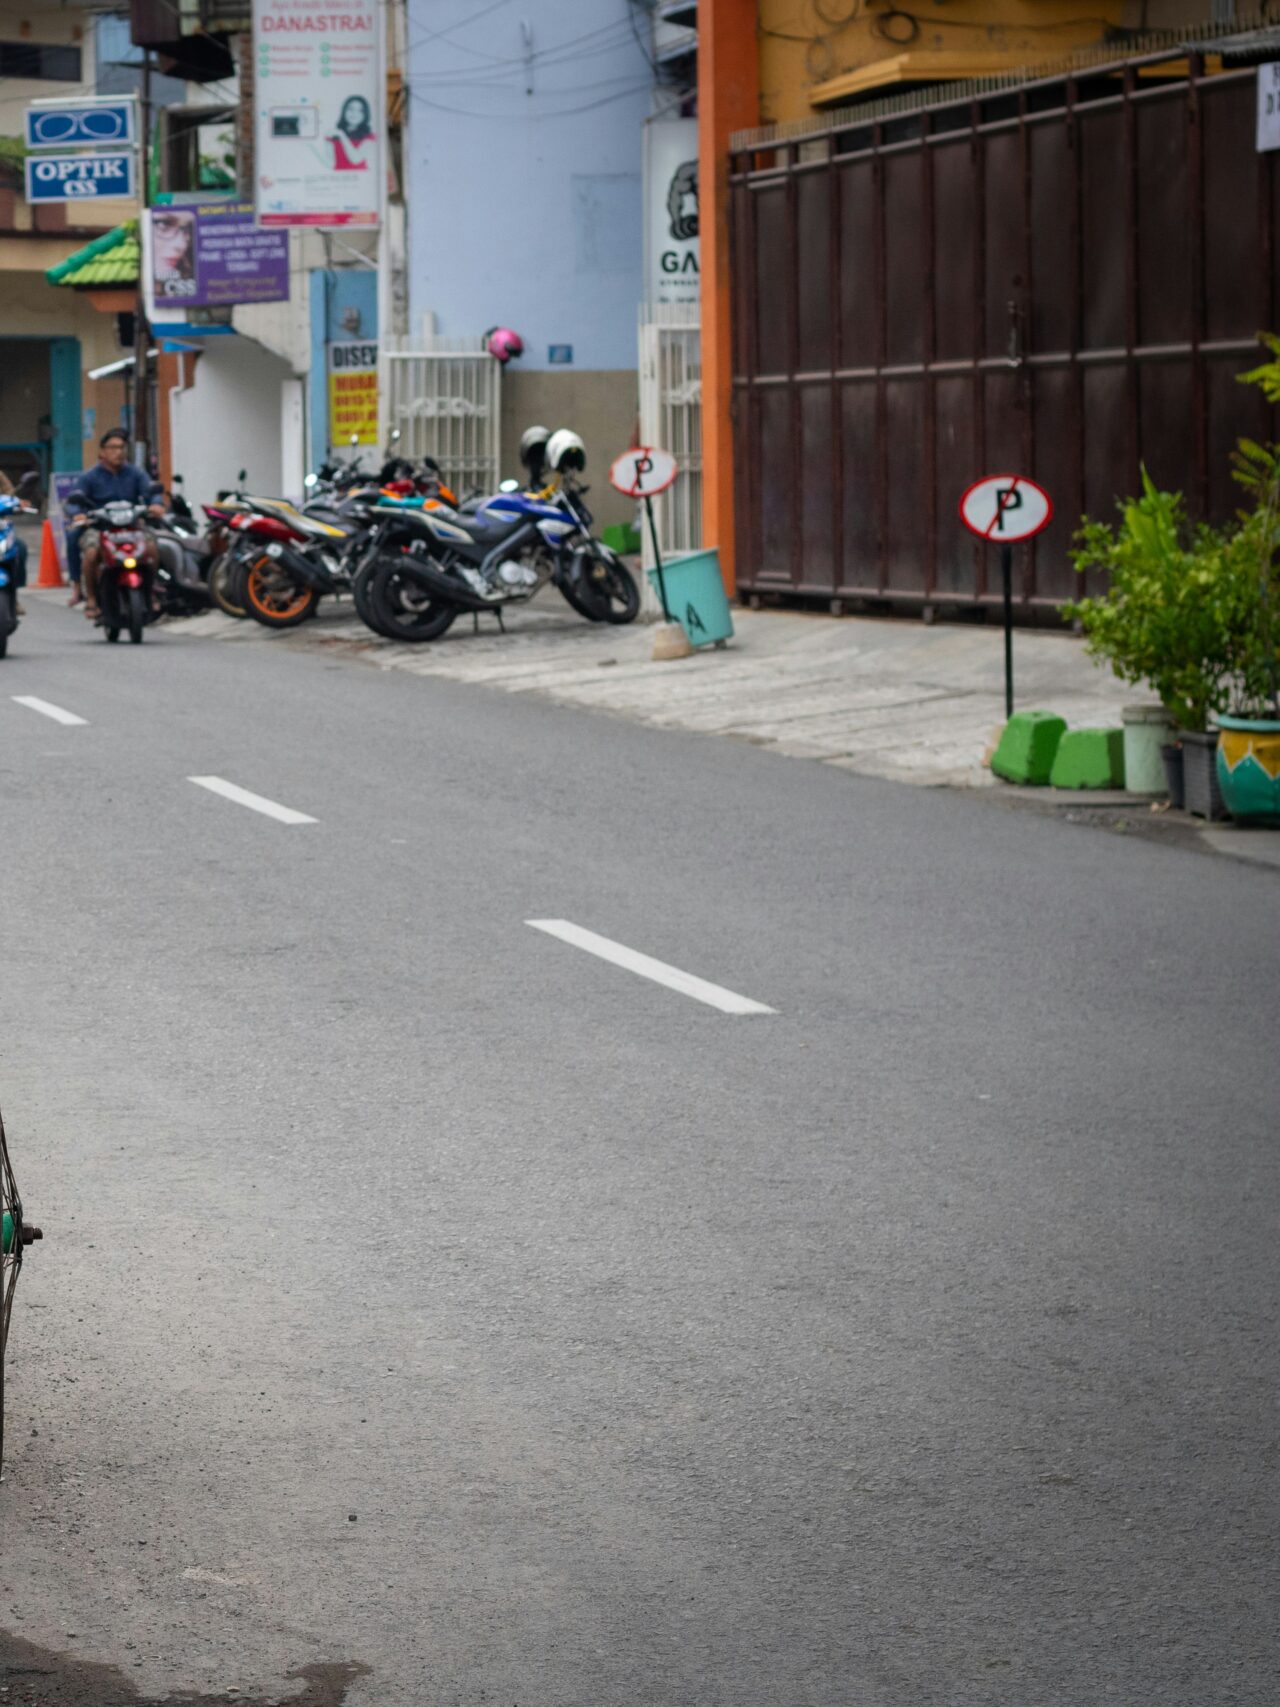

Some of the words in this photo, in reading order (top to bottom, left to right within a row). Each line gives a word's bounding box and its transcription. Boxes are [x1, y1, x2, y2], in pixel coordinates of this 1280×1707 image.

[261, 15, 373, 33] DANASTRA!
[35, 160, 125, 181] OPTIK
[63, 180, 98, 197] CSS
[164, 279, 196, 298] CSS
[634, 457, 654, 490] P
[996, 489, 1023, 531] P
